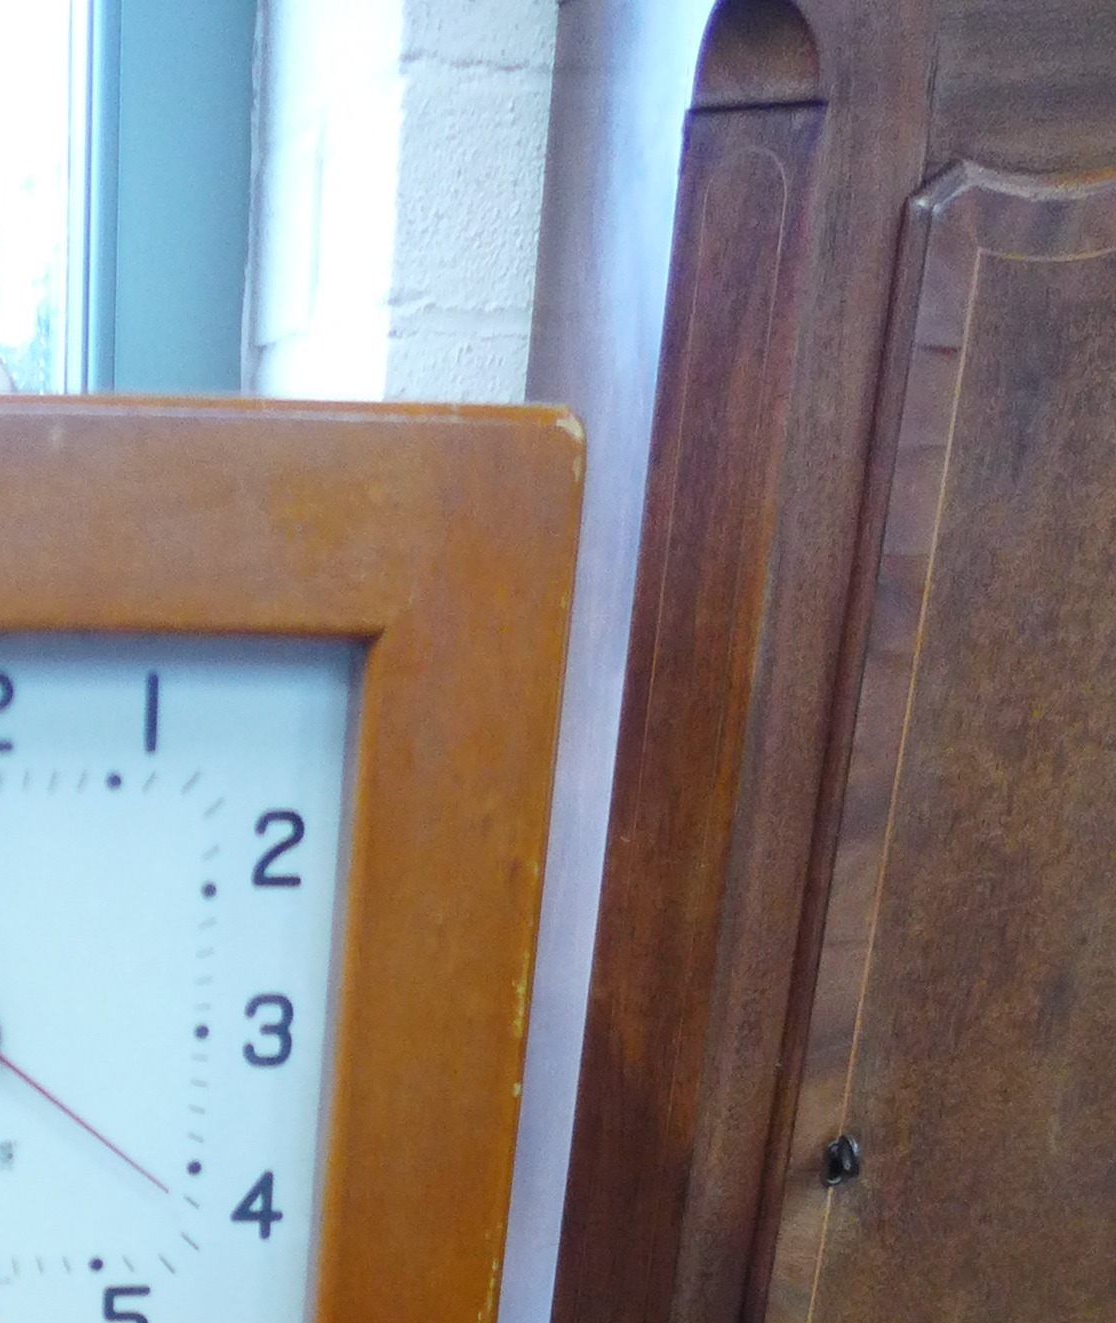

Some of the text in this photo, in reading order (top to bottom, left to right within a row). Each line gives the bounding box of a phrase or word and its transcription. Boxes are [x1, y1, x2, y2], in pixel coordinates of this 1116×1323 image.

[145, 671, 159, 753] 1
[251, 809, 305, 888] 2
[242, 993, 295, 1068] 3
[230, 1171, 284, 1240] 4
